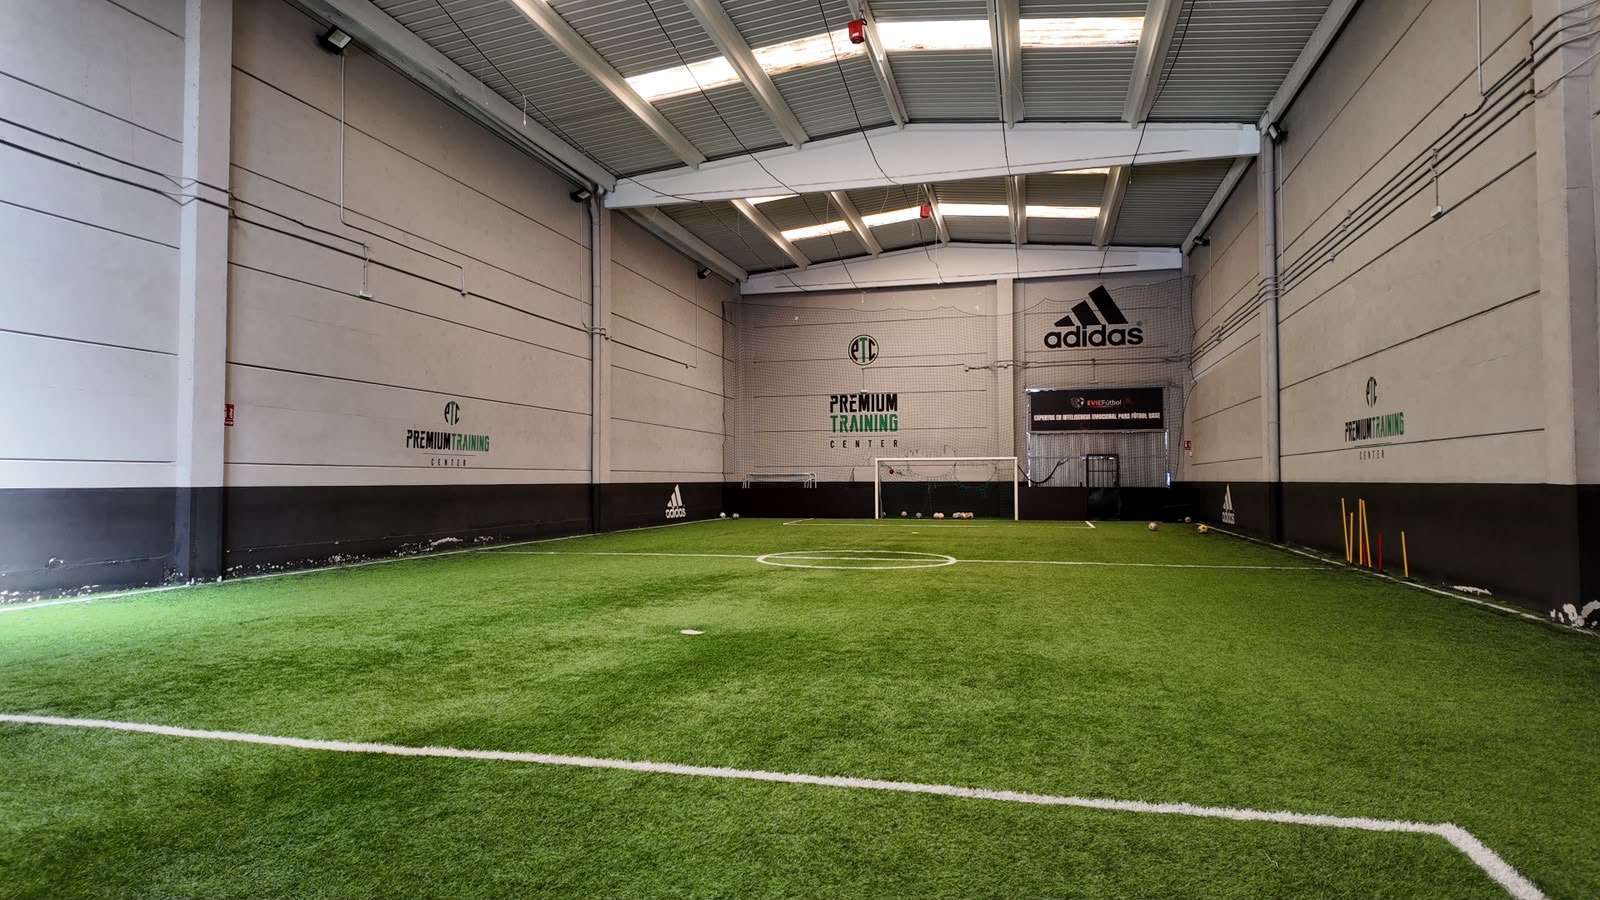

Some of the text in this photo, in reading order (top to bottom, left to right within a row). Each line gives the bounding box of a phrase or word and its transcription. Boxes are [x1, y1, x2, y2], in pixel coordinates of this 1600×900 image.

[1044, 324, 1144, 348] adidas
[830, 393, 898, 413] PREMIUM
[830, 414, 898, 432] TRAINING
[830, 440, 898, 448] CENTER
[1360, 449, 1384, 460] CENTER
[431, 458, 466, 467] CENTER
[665, 505, 686, 518] adidas
